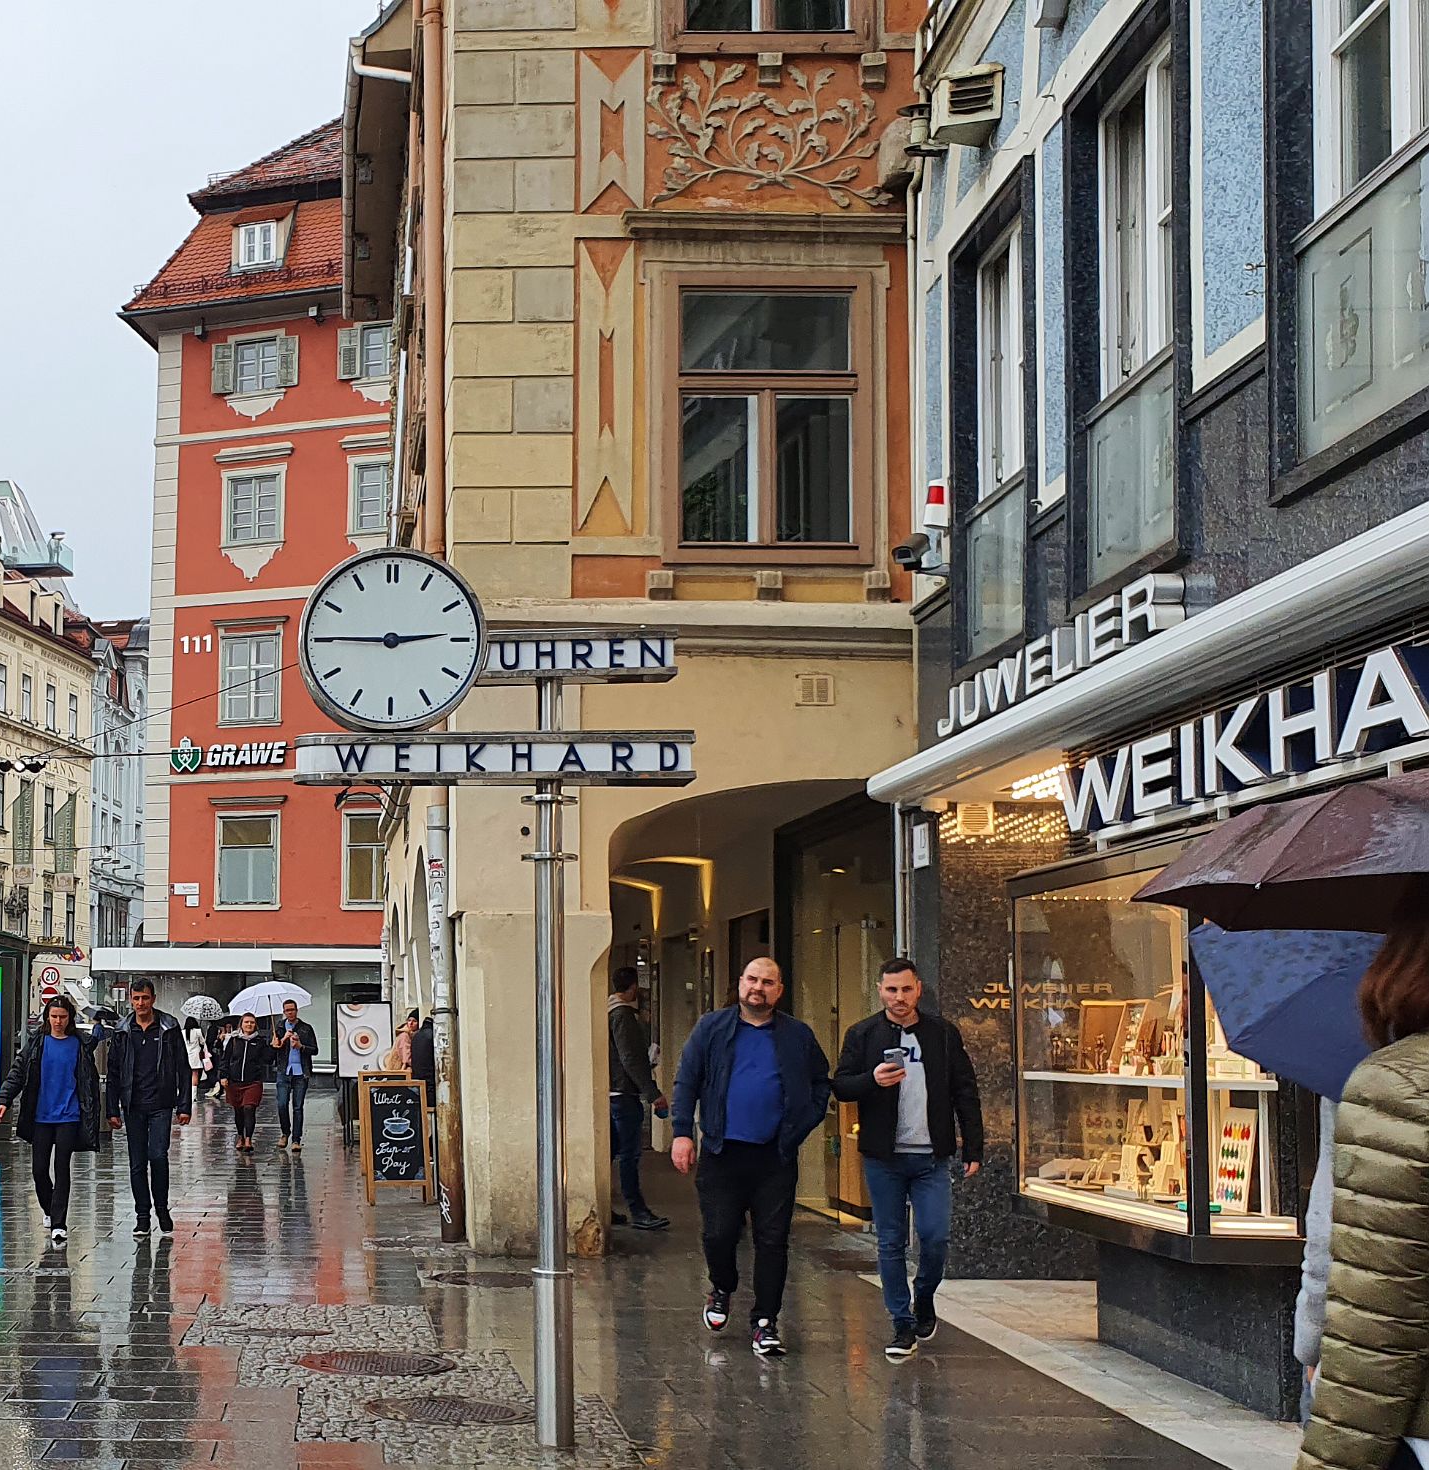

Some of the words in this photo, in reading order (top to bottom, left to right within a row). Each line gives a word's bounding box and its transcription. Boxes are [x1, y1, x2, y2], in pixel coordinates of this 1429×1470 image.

[180, 634, 212, 653] 111
[499, 638, 666, 671] UHREN
[937, 573, 1185, 738] JUWELIER
[1062, 646, 1429, 832] WEIKHA
[206, 741, 287, 766] GRAWE
[335, 742, 680, 773] WEIKHARD
[45, 971, 56, 981] 20
[902, 1046, 924, 1062] PL
[381, 1157, 410, 1175] Day
